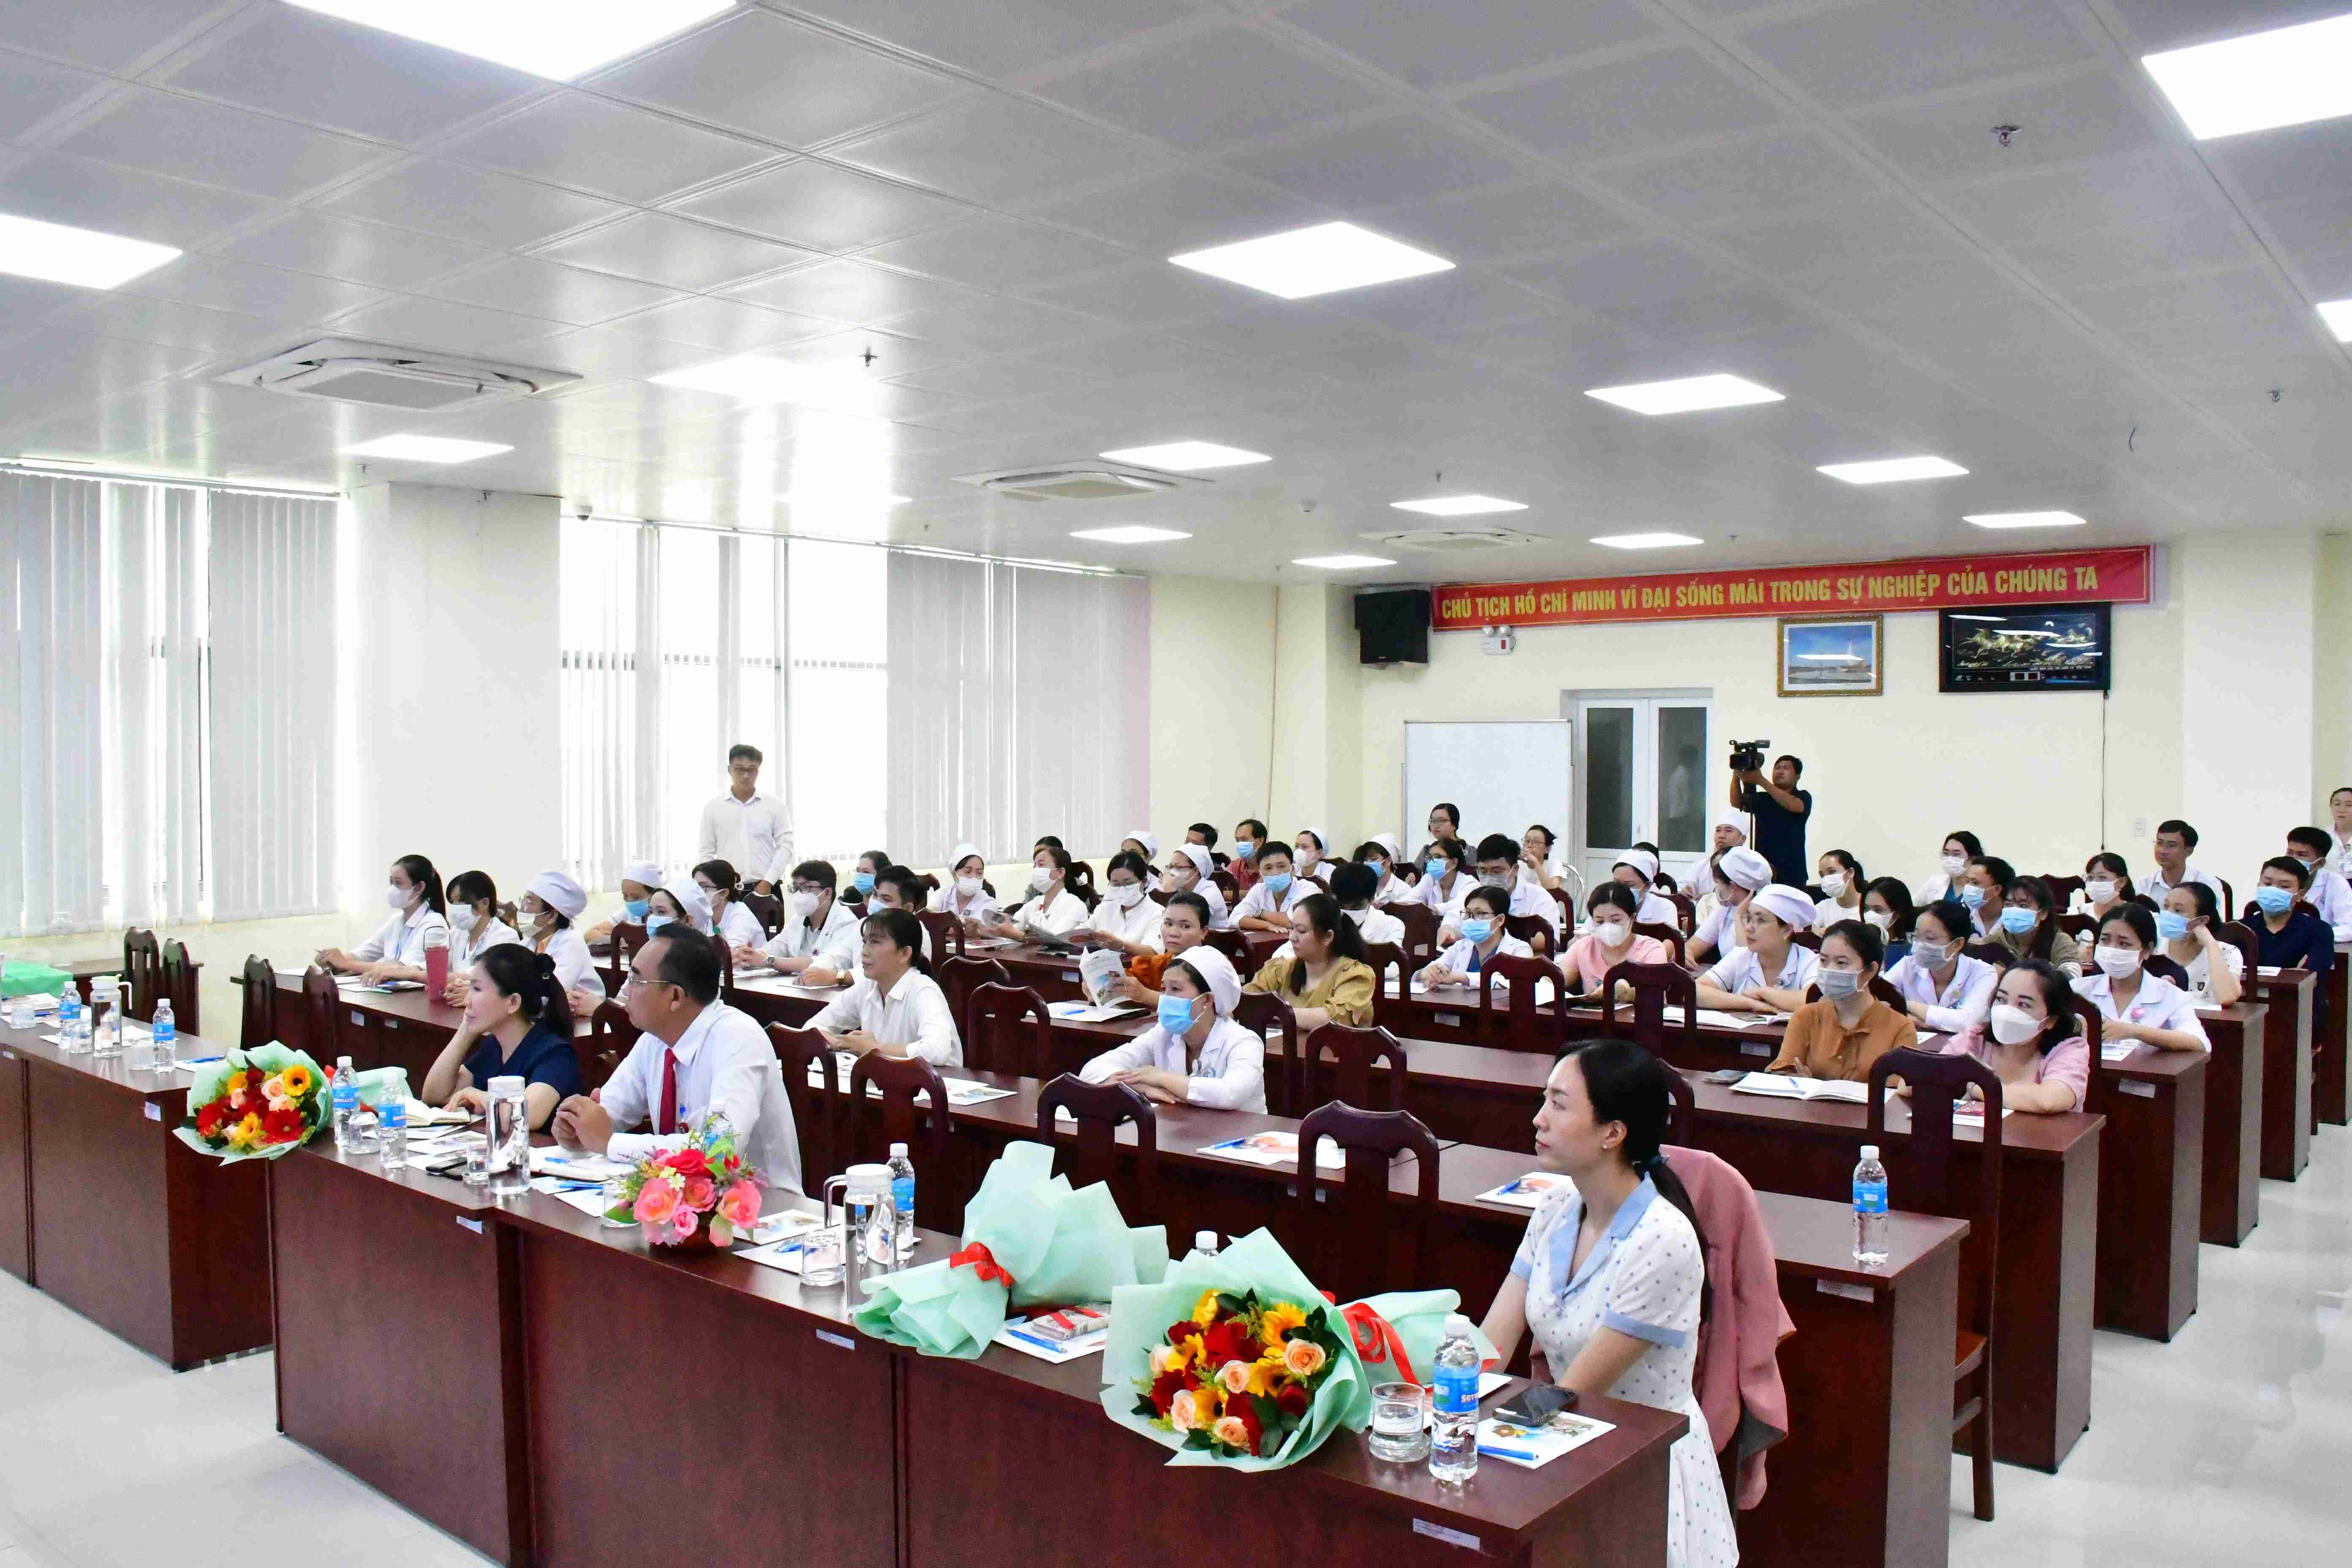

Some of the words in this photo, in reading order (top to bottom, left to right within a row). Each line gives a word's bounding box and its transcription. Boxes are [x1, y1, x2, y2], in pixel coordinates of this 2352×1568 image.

[1476, 596, 1510, 620] TỊCH
[1541, 589, 1567, 613] CHÍ
[1572, 590, 1616, 611] MINH
[1676, 578, 1723, 607] SỐNG
[1729, 578, 1764, 604] MÃI
[1769, 578, 1831, 602] TRONG
[1838, 575, 1864, 604] SỰ
[1868, 569, 1940, 601] NGHIỆP
[1947, 564, 1989, 595] CỦA
[1995, 564, 2067, 593] CHÚNG
[2074, 566, 2098, 590] TA
